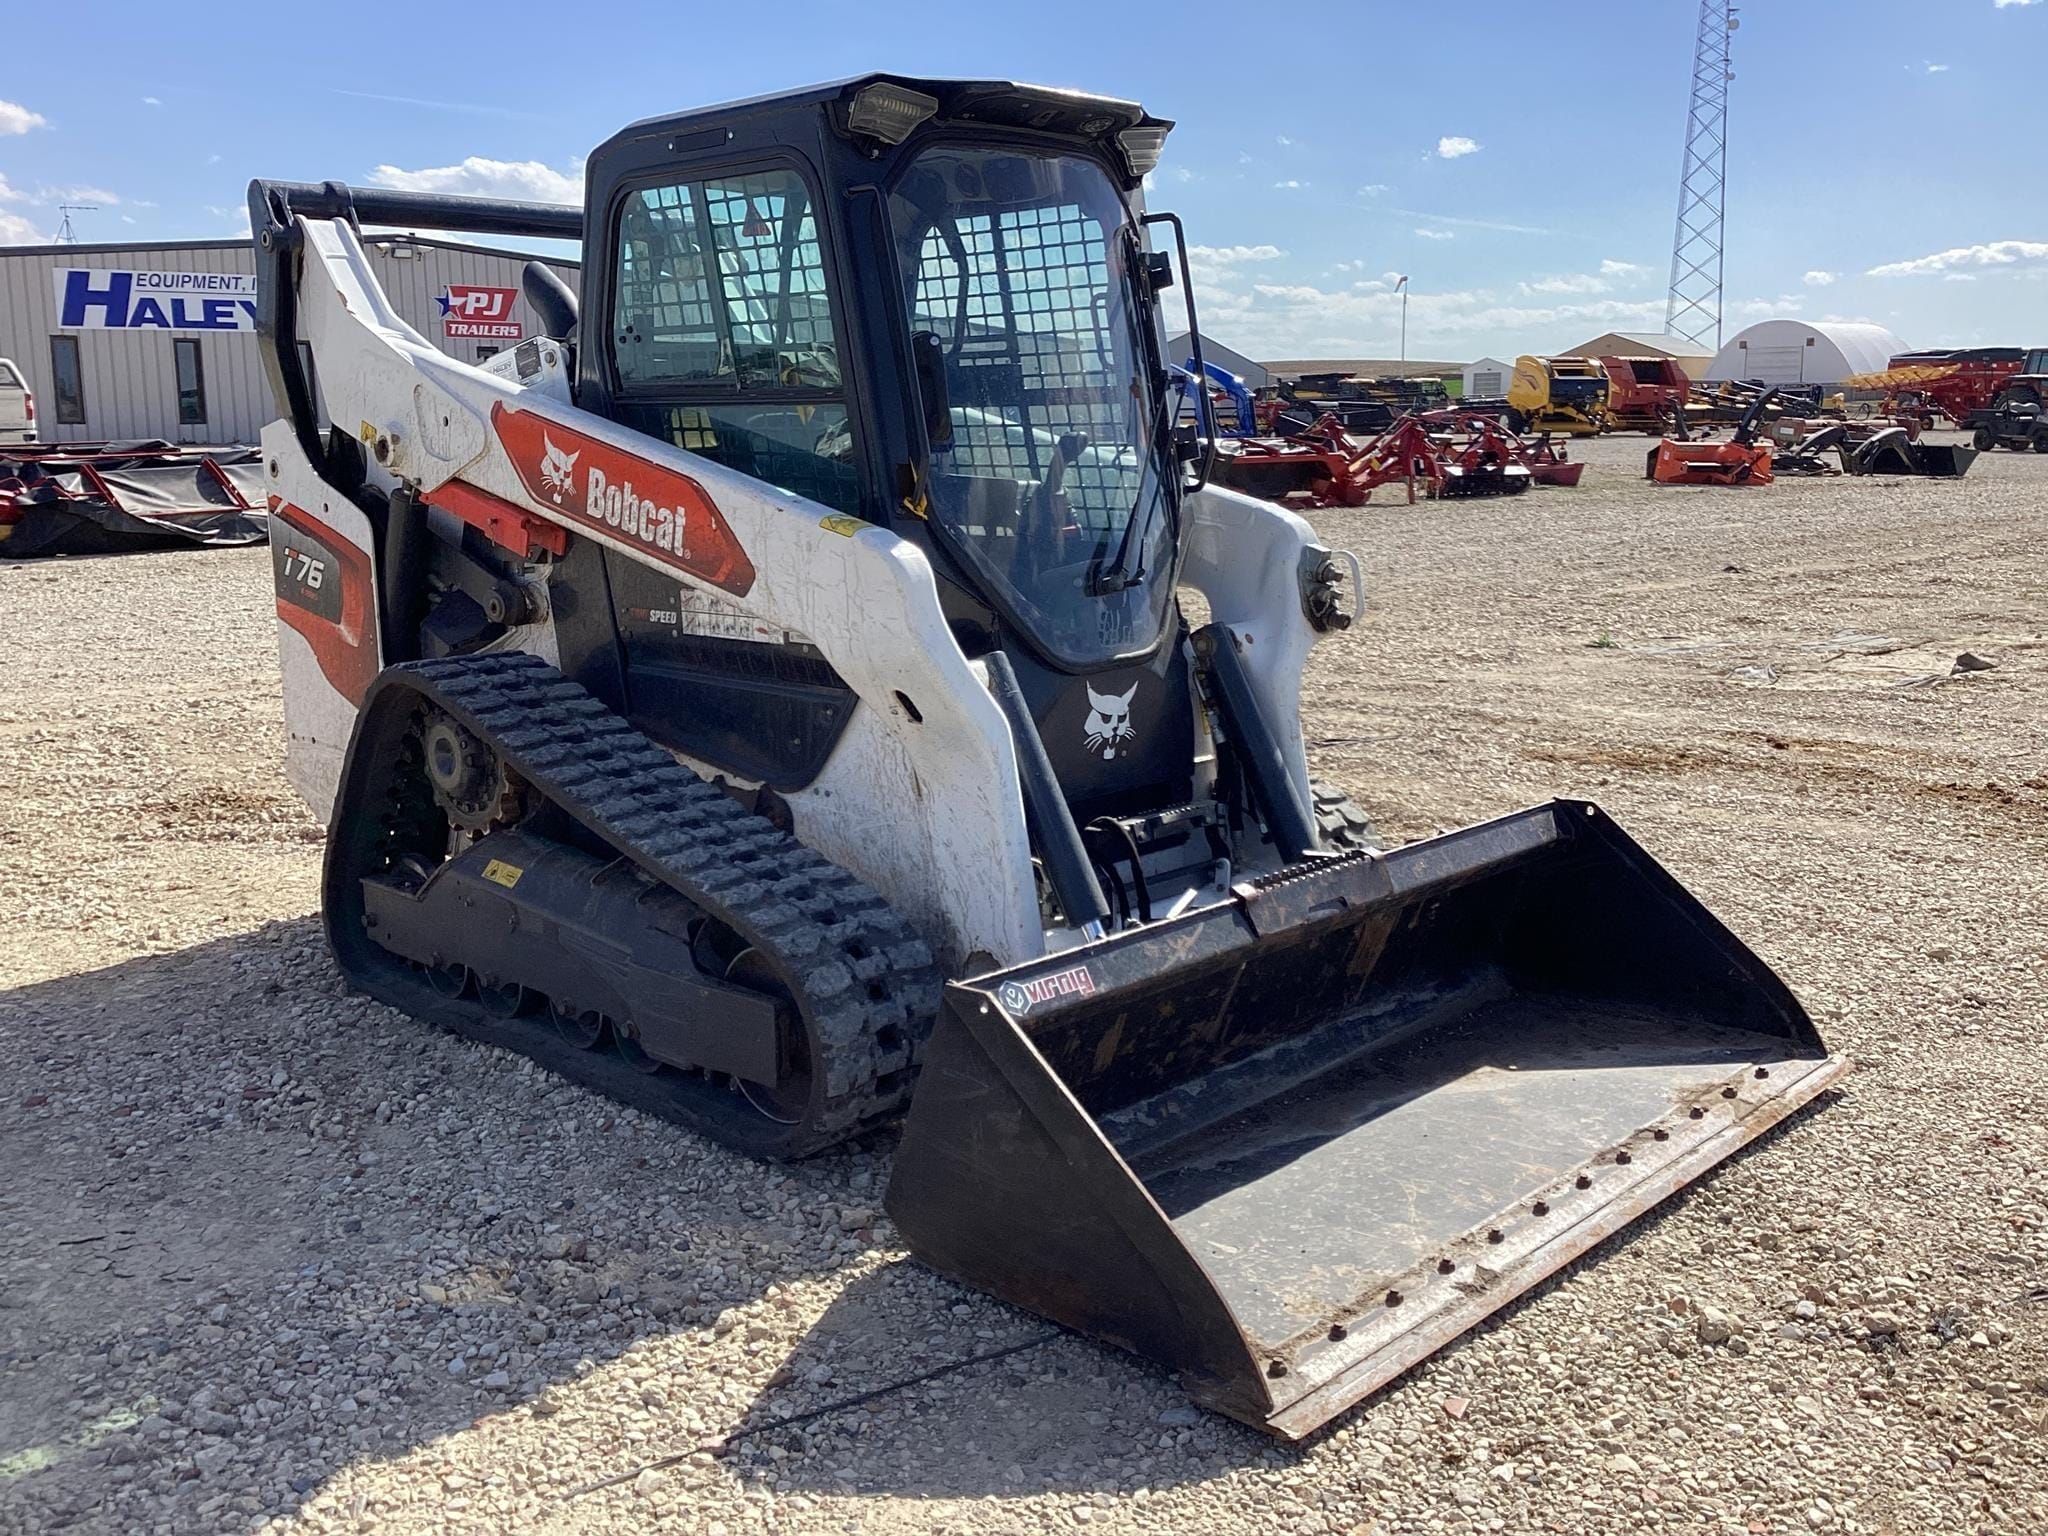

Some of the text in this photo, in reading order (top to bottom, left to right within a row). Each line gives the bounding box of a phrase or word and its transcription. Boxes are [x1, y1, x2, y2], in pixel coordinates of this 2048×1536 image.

[136, 273, 246, 291] EQUIPMENT,
[464, 292, 503, 316] PJ
[449, 324, 519, 336] TRAILERS
[587, 466, 686, 557] Bobcat
[284, 547, 325, 589] T76
